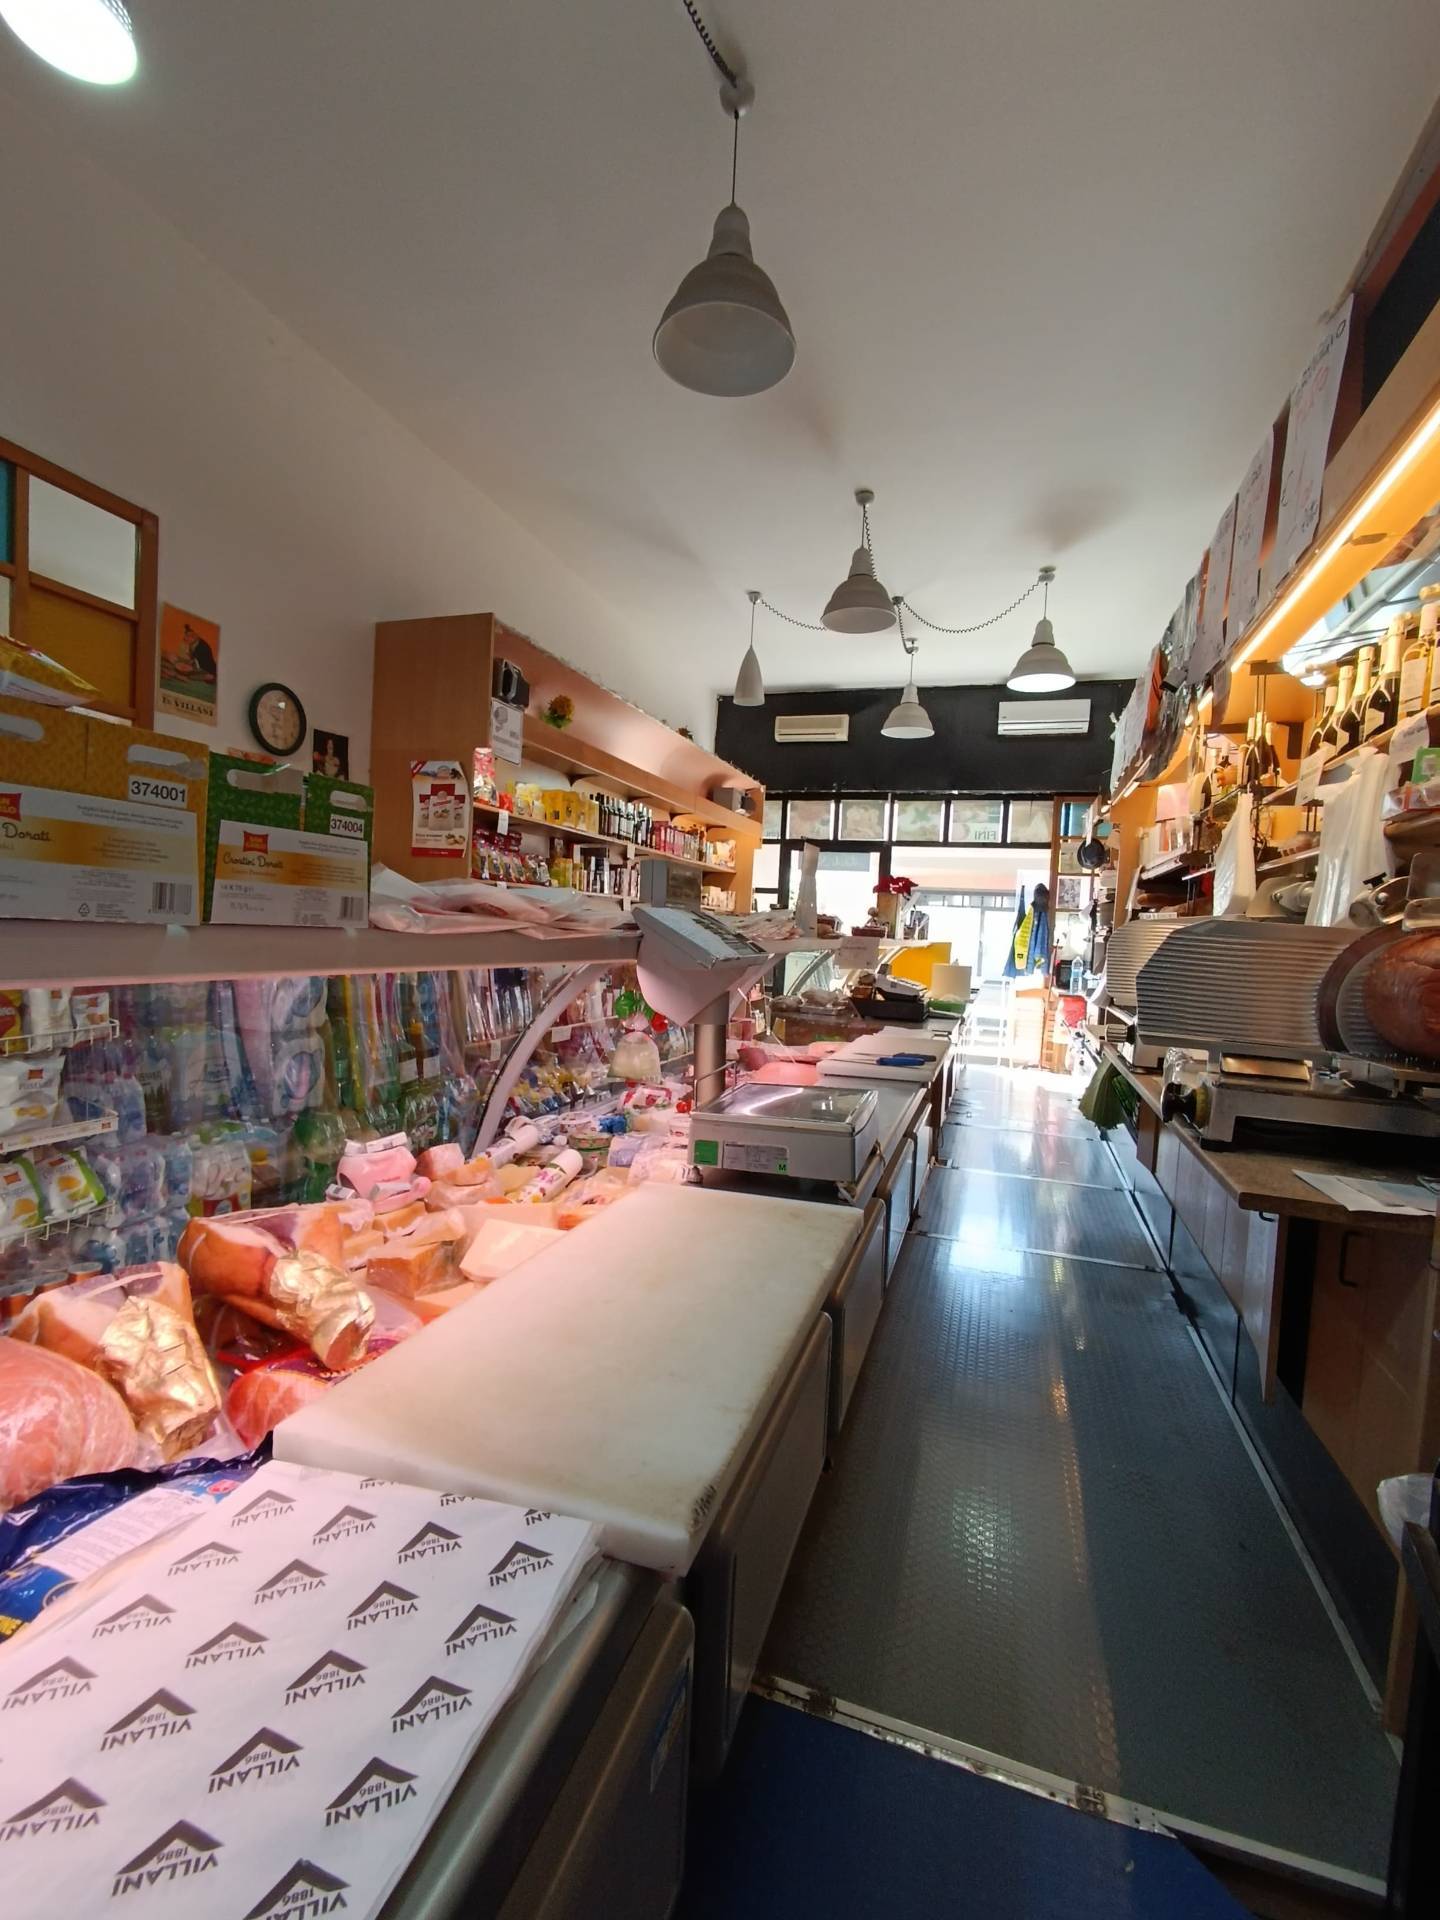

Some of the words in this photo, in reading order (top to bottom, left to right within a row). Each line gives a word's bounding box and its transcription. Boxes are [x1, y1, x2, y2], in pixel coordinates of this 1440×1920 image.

[130, 780, 186, 803] 374001
[2, 822, 52, 842] Dorati
[330, 818, 363, 833] 374004
[778, 1164, 787, 1172] M
[231, 1505, 294, 1528] VILLANI
[312, 1521, 376, 1546] VILLANI
[398, 1541, 463, 1564] VILLANI
[510, 1556, 531, 1567] 1886
[168, 1555, 240, 1577] VILLANI
[489, 1558, 554, 1588] VILLANI
[254, 1578, 325, 1605] VILLANI
[92, 1616, 172, 1639] VILLANI
[347, 1602, 419, 1631] VILLANI
[469, 1621, 494, 1633] 1886
[445, 1624, 518, 1656] VILLANI
[184, 1644, 266, 1669] VILLANI
[314, 1669, 341, 1683] 1886
[1, 1681, 92, 1711] VILLANI
[284, 1673, 367, 1706] VILLANI
[419, 1693, 447, 1708] 1886
[392, 1695, 473, 1734] VILLANI
[100, 1718, 193, 1752] VILLANI
[244, 1750, 273, 1765] 1886
[208, 1755, 301, 1794] VILLANI
[358, 1781, 388, 1798] 1886
[325, 1783, 418, 1828] VILLANI
[0, 1811, 100, 1842] VILLANI
[155, 1846, 190, 1865] 1886
[111, 1853, 219, 1898] VILLANI
[281, 1887, 315, 1907] 1886
